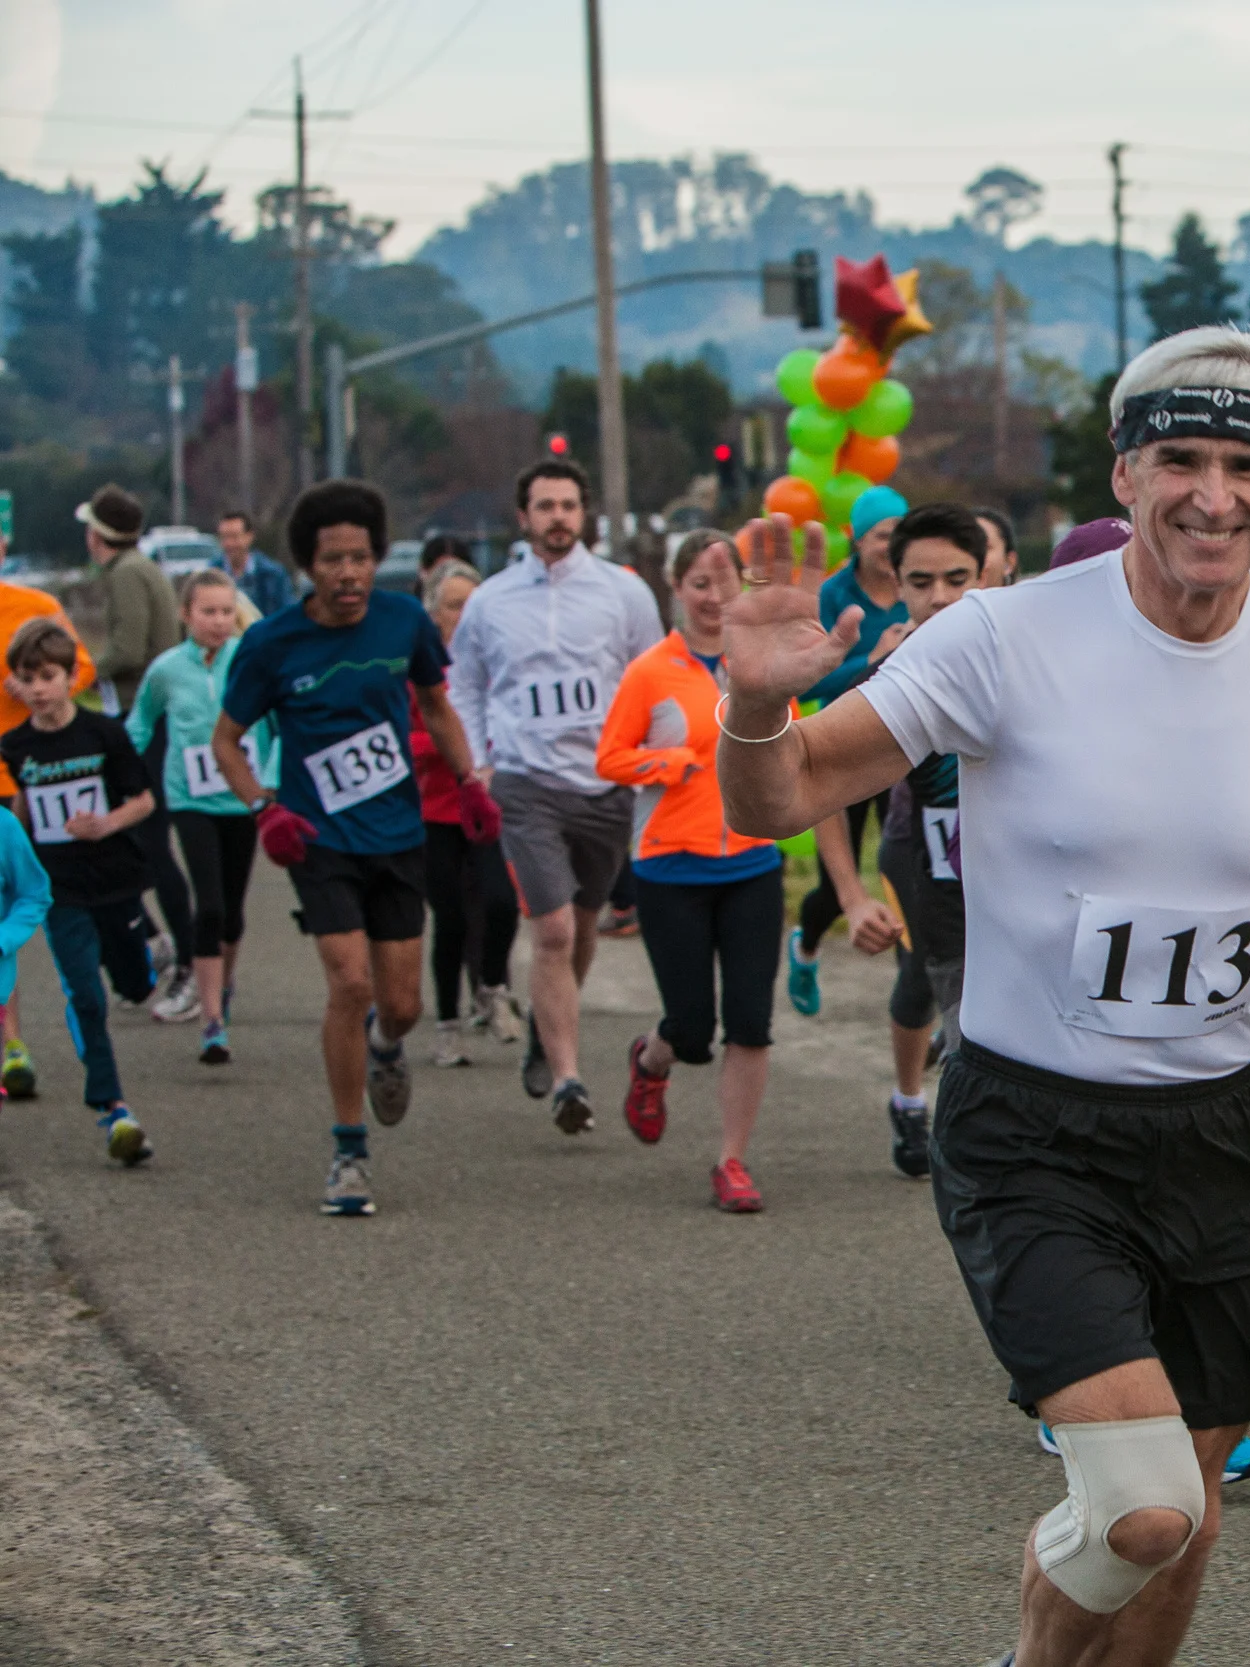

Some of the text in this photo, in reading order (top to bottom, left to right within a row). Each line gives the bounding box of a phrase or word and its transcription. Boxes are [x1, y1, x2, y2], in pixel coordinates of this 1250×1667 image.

[528, 677, 596, 717] 110
[321, 733, 396, 794] 138
[36, 784, 97, 829] 117
